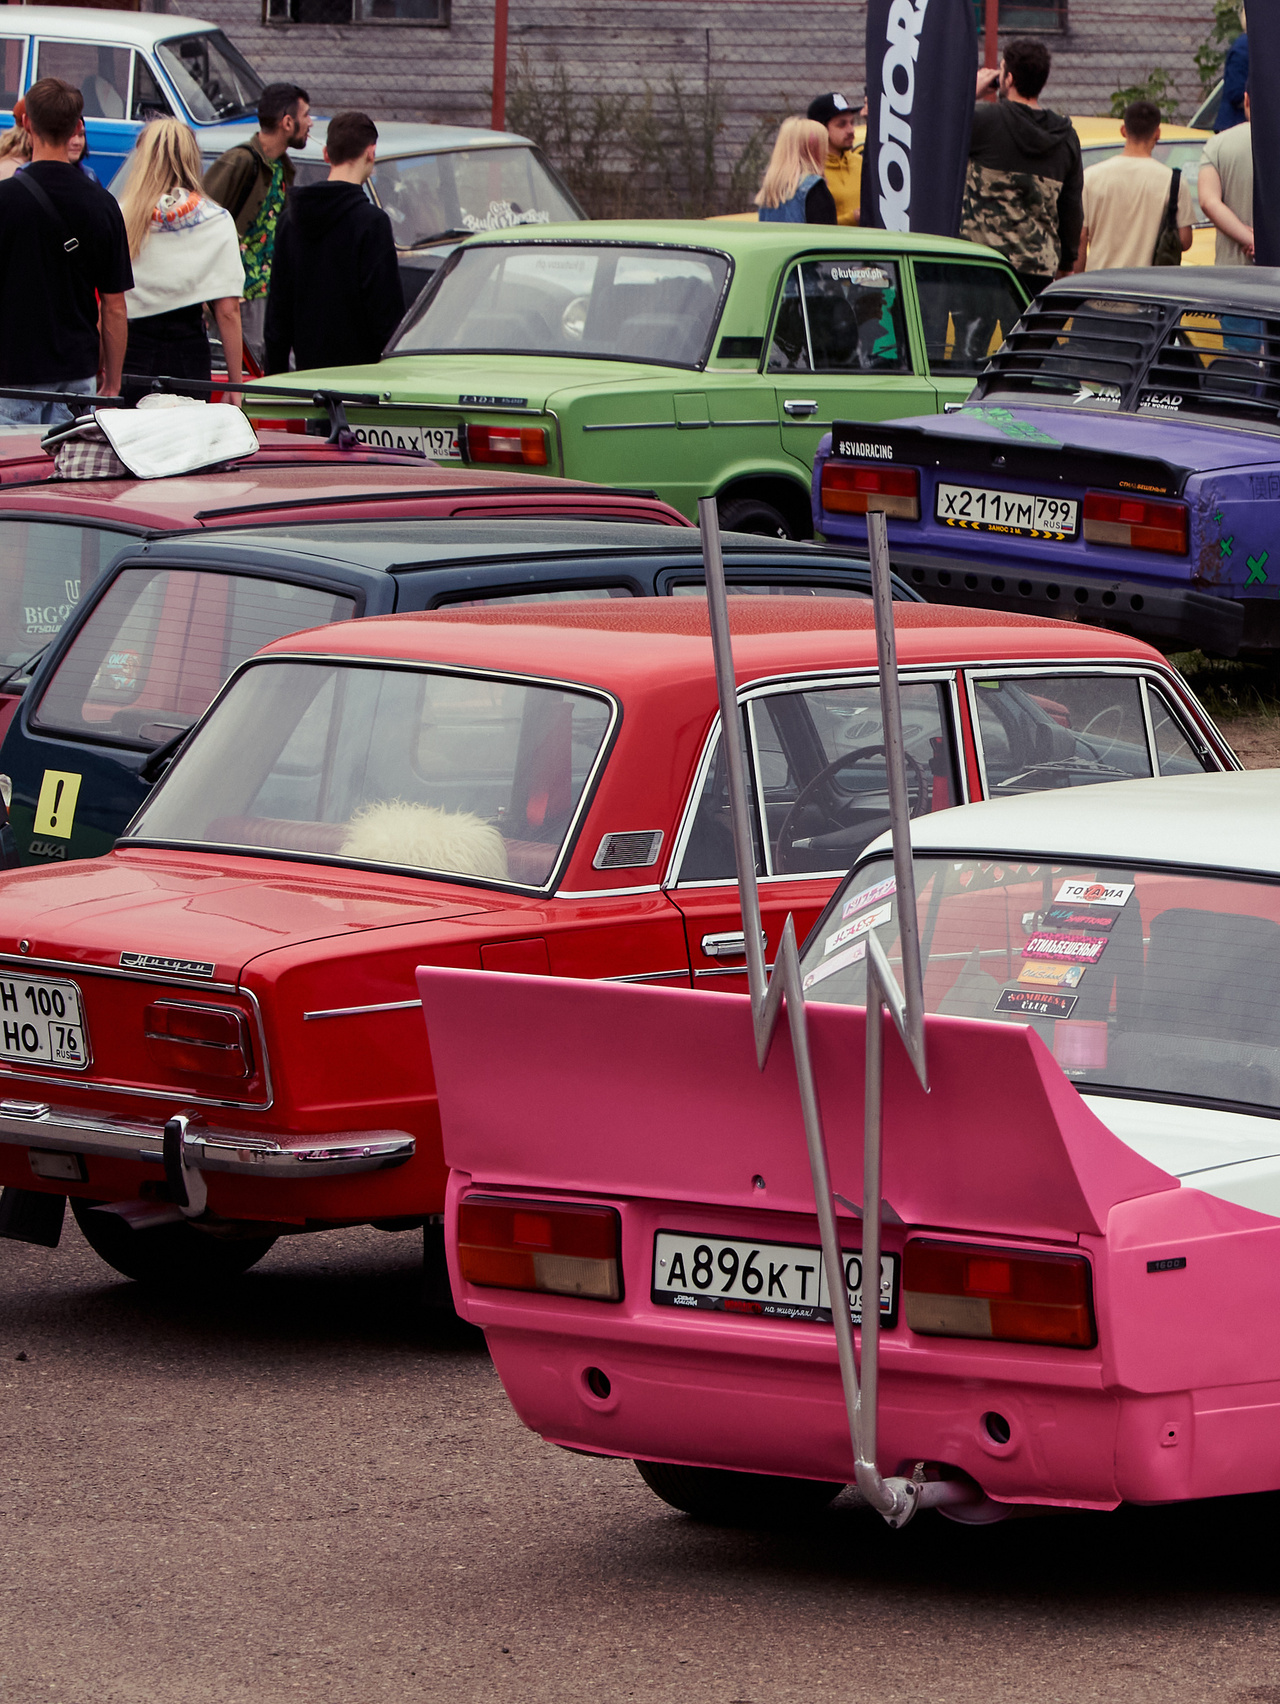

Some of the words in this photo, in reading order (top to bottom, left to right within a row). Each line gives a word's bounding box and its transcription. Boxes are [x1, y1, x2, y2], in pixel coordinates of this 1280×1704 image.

[831, 266, 883, 280] @kutuzov.ph
[424, 430, 454, 449] 197
[944, 490, 1033, 525] Х211УМ
[1036, 498, 1071, 522] 799
[1043, 519, 1061, 530] RUS
[1066, 885, 1125, 899] TOYAMA
[1027, 938, 1102, 957] СТИЛЬБЕШЕНЫЙ
[122, 955, 213, 973] Жигули
[1021, 1000, 1049, 1013] CLUB
[3, 1020, 39, 1052] НО
[55, 1025, 77, 1051] 76
[56, 1050, 71, 1060] RUS
[666, 1244, 815, 1300] А896КТ
